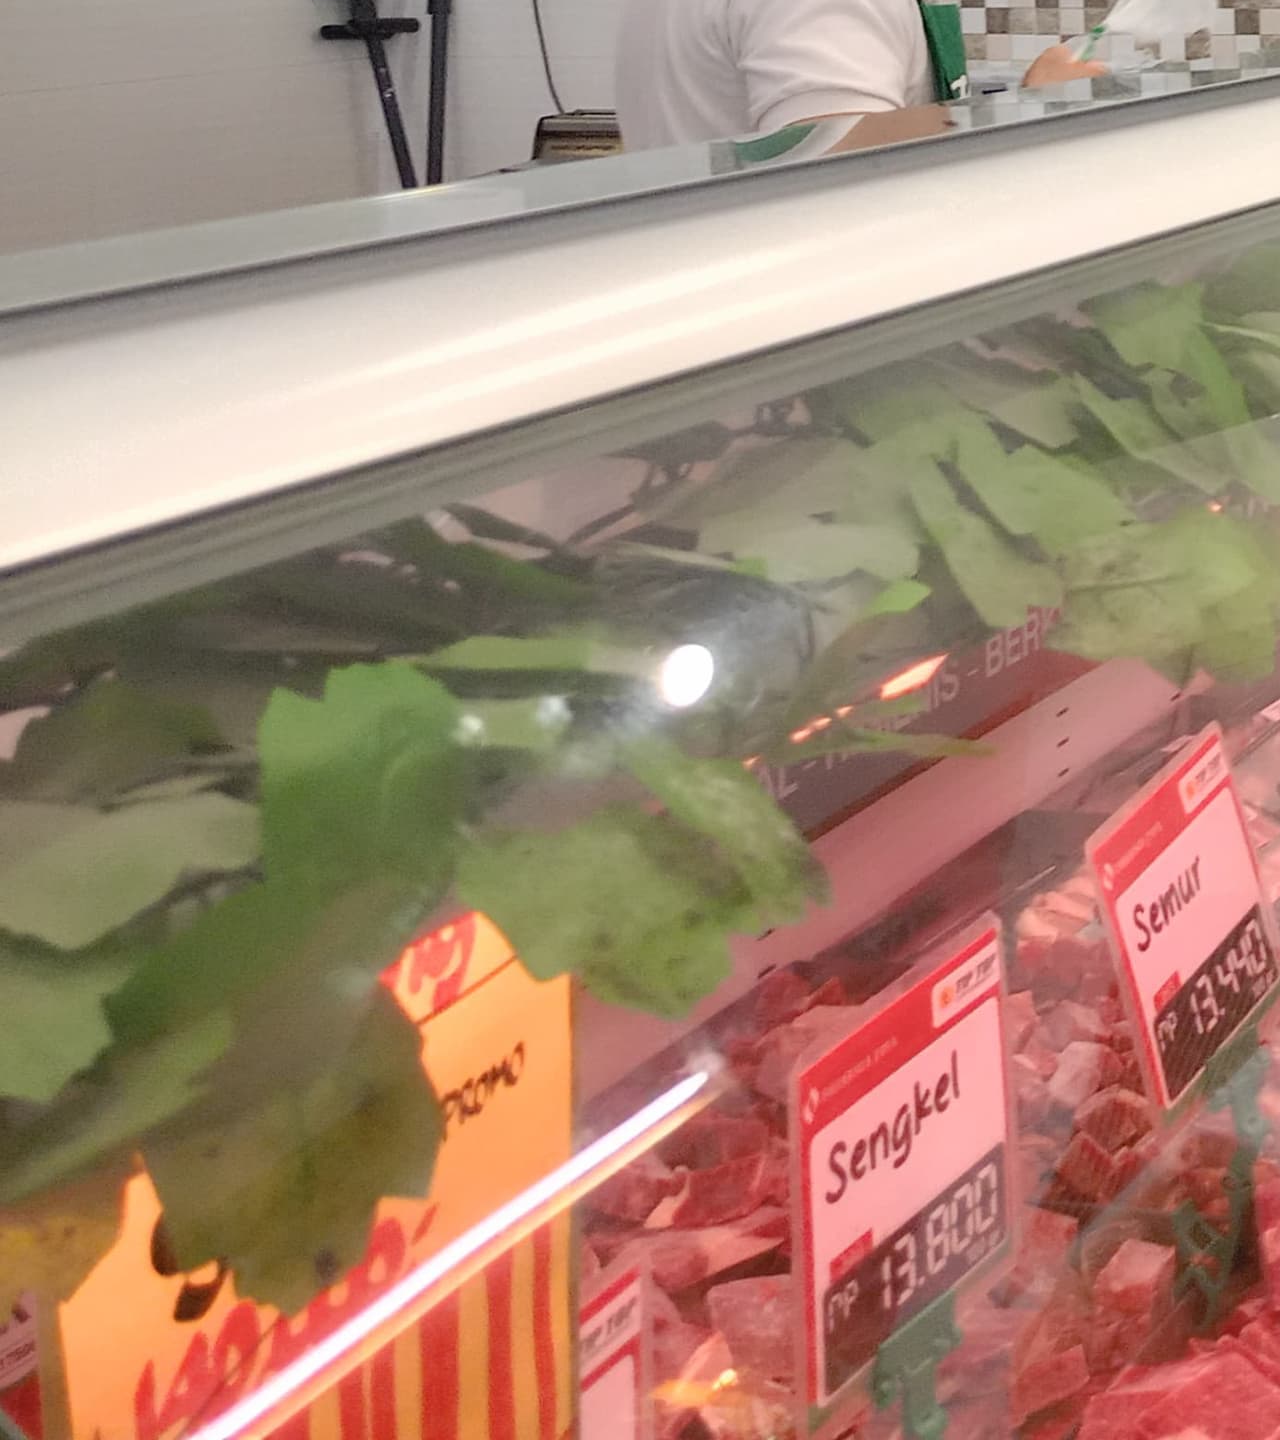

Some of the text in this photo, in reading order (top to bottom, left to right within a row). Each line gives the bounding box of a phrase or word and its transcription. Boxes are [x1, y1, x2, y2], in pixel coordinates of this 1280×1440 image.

[1133, 856, 1201, 952] Semur
[440, 1041, 526, 1142] PROMO
[825, 1050, 959, 1204] Sengkel
[881, 1162, 998, 1310] 13.800
